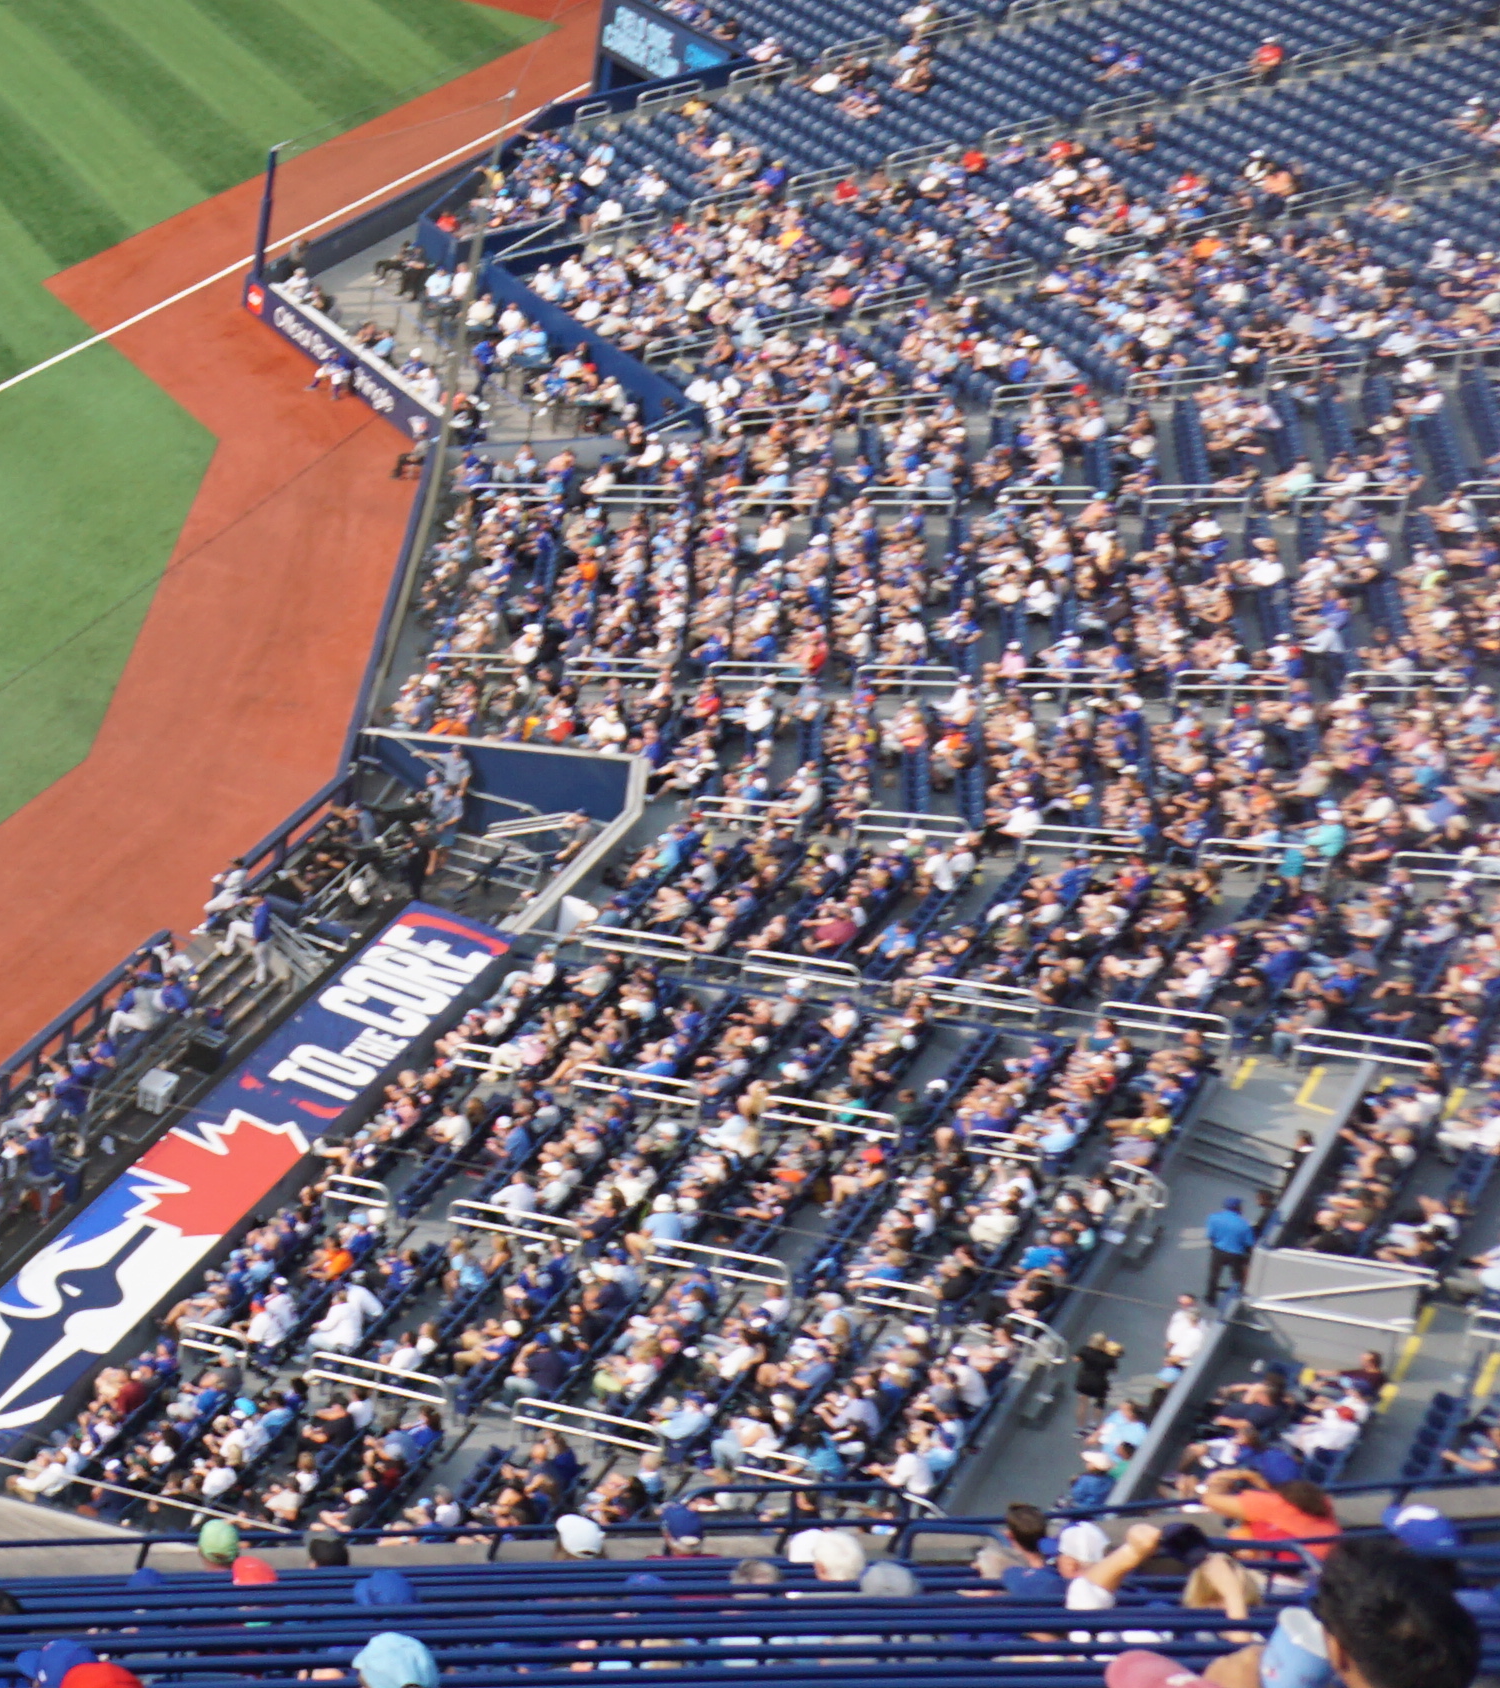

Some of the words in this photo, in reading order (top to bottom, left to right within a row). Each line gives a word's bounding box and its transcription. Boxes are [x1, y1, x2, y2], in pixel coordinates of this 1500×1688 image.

[319, 924, 493, 1041] CORE
[268, 1043, 376, 1101] TO
[344, 1025, 408, 1074] THE
